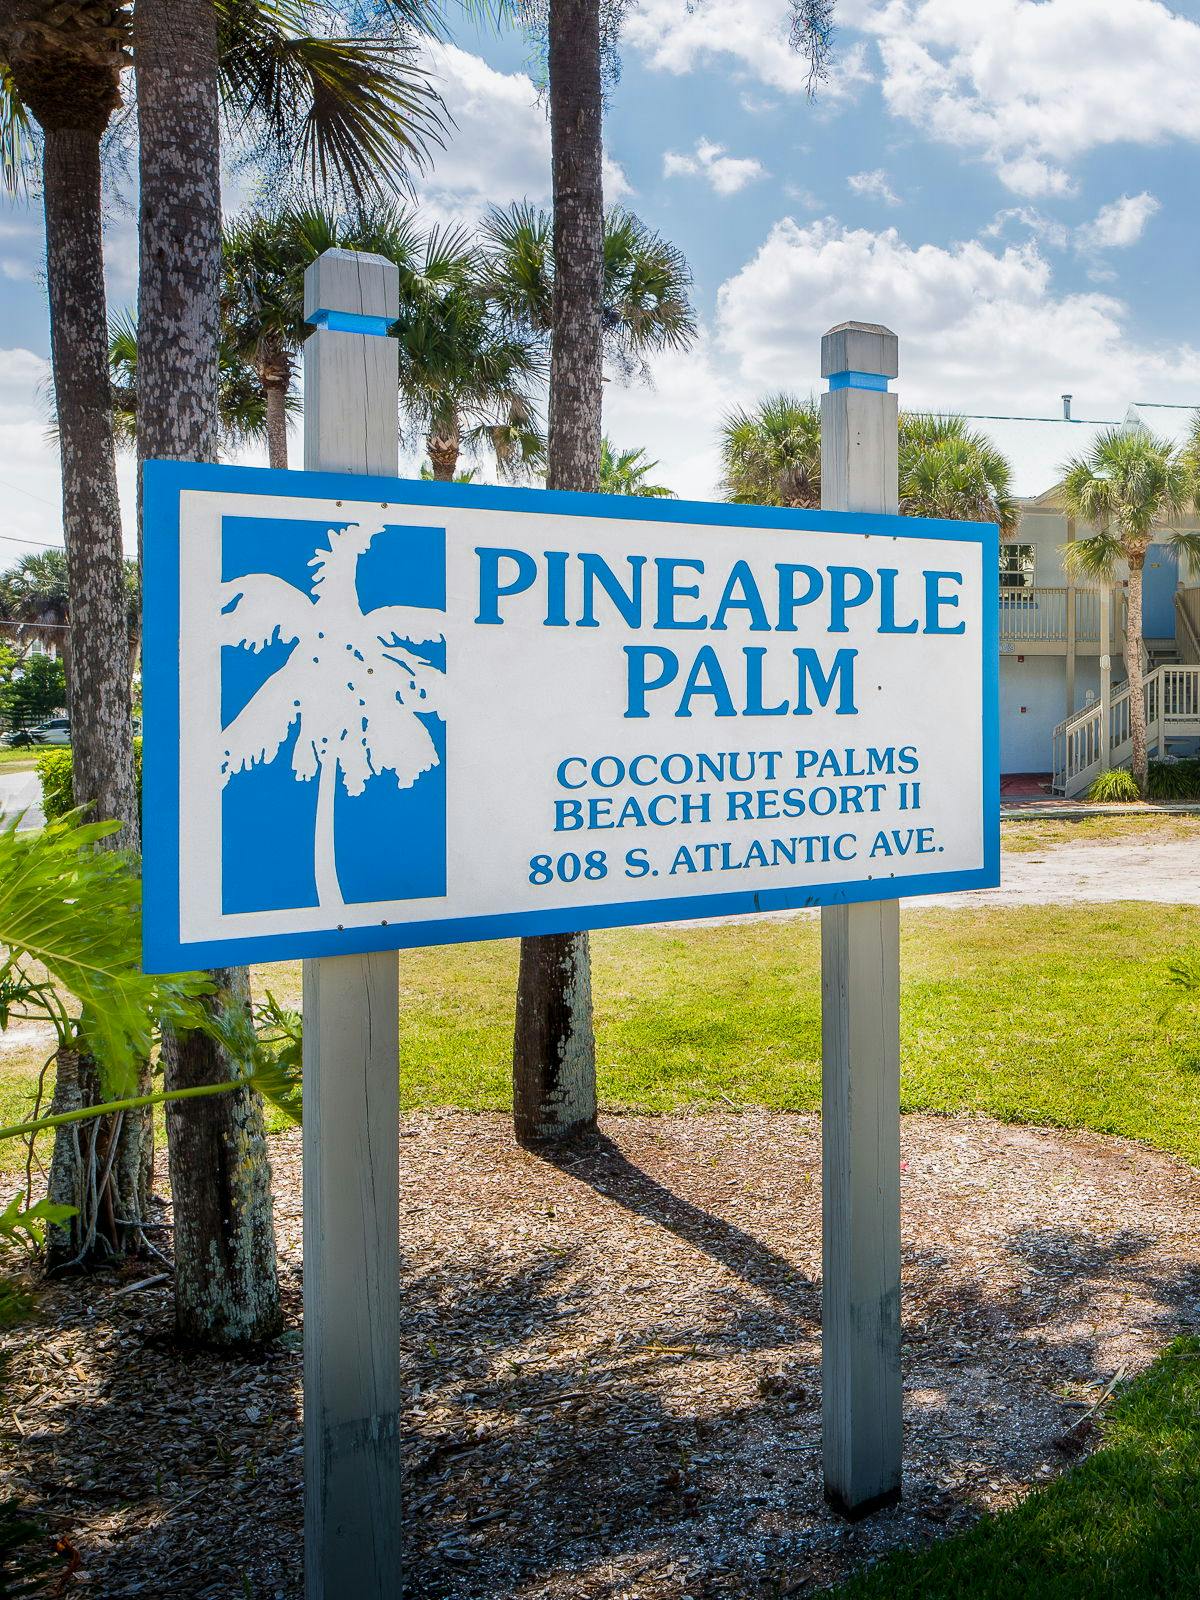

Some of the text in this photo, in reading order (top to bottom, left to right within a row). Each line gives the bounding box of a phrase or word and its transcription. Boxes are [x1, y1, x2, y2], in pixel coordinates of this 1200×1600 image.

[474, 547, 966, 635] PINEAPPLE
[623, 645, 859, 719] PALM
[557, 746, 919, 790] COCONUT PALMS
[554, 782, 921, 833] BEACH RESORT II
[528, 827, 945, 885] 808 S. ATLANTIC AVE.
